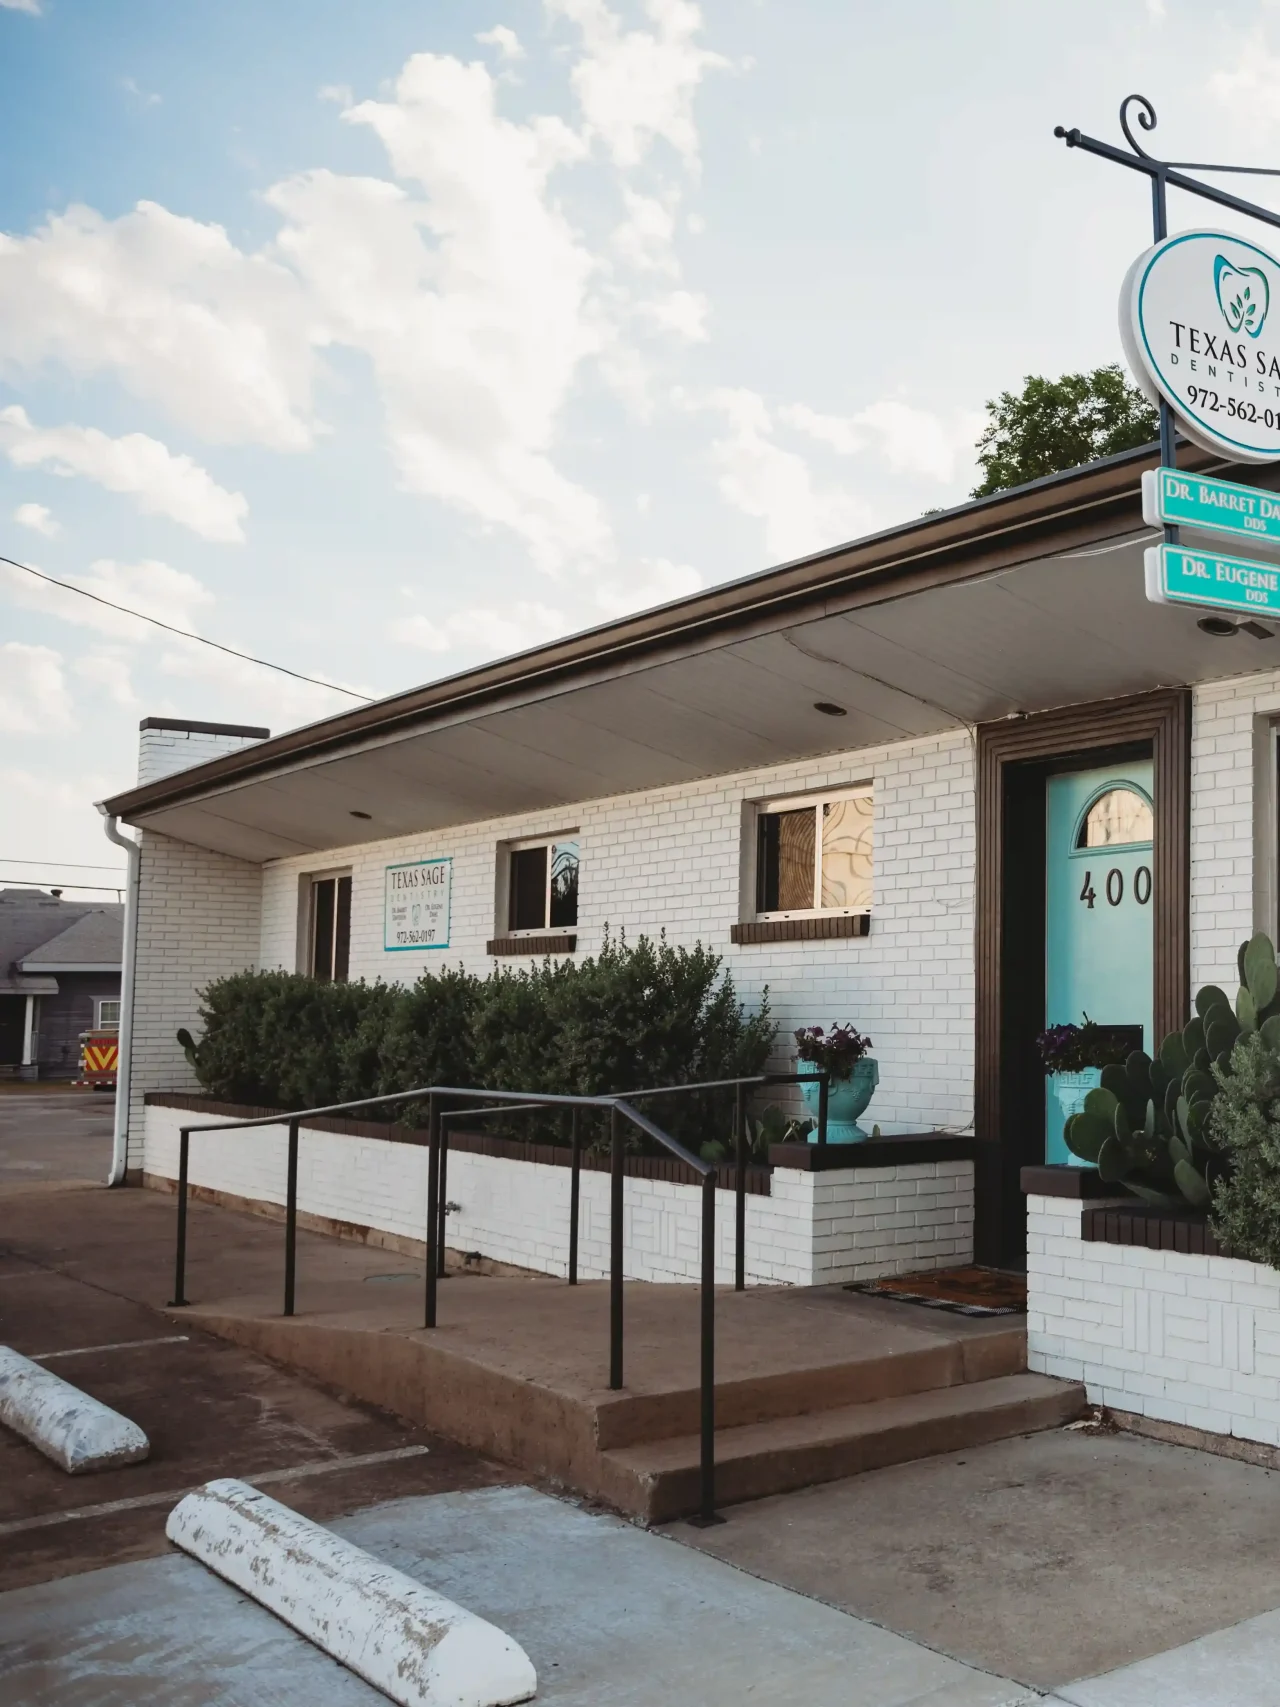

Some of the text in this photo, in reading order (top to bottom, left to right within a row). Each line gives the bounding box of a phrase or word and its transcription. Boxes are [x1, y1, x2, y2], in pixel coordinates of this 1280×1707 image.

[1169, 321, 1247, 369] TEXAS
[1199, 485, 1256, 514] BARRET
[1243, 516, 1267, 532] DDS
[1215, 562, 1278, 591] EUGENE
[1245, 588, 1269, 604] DDS
[391, 866, 445, 890] TEXAS SAGE
[1079, 865, 1152, 909] 400
[396, 929, 436, 943] 972-562-0197
